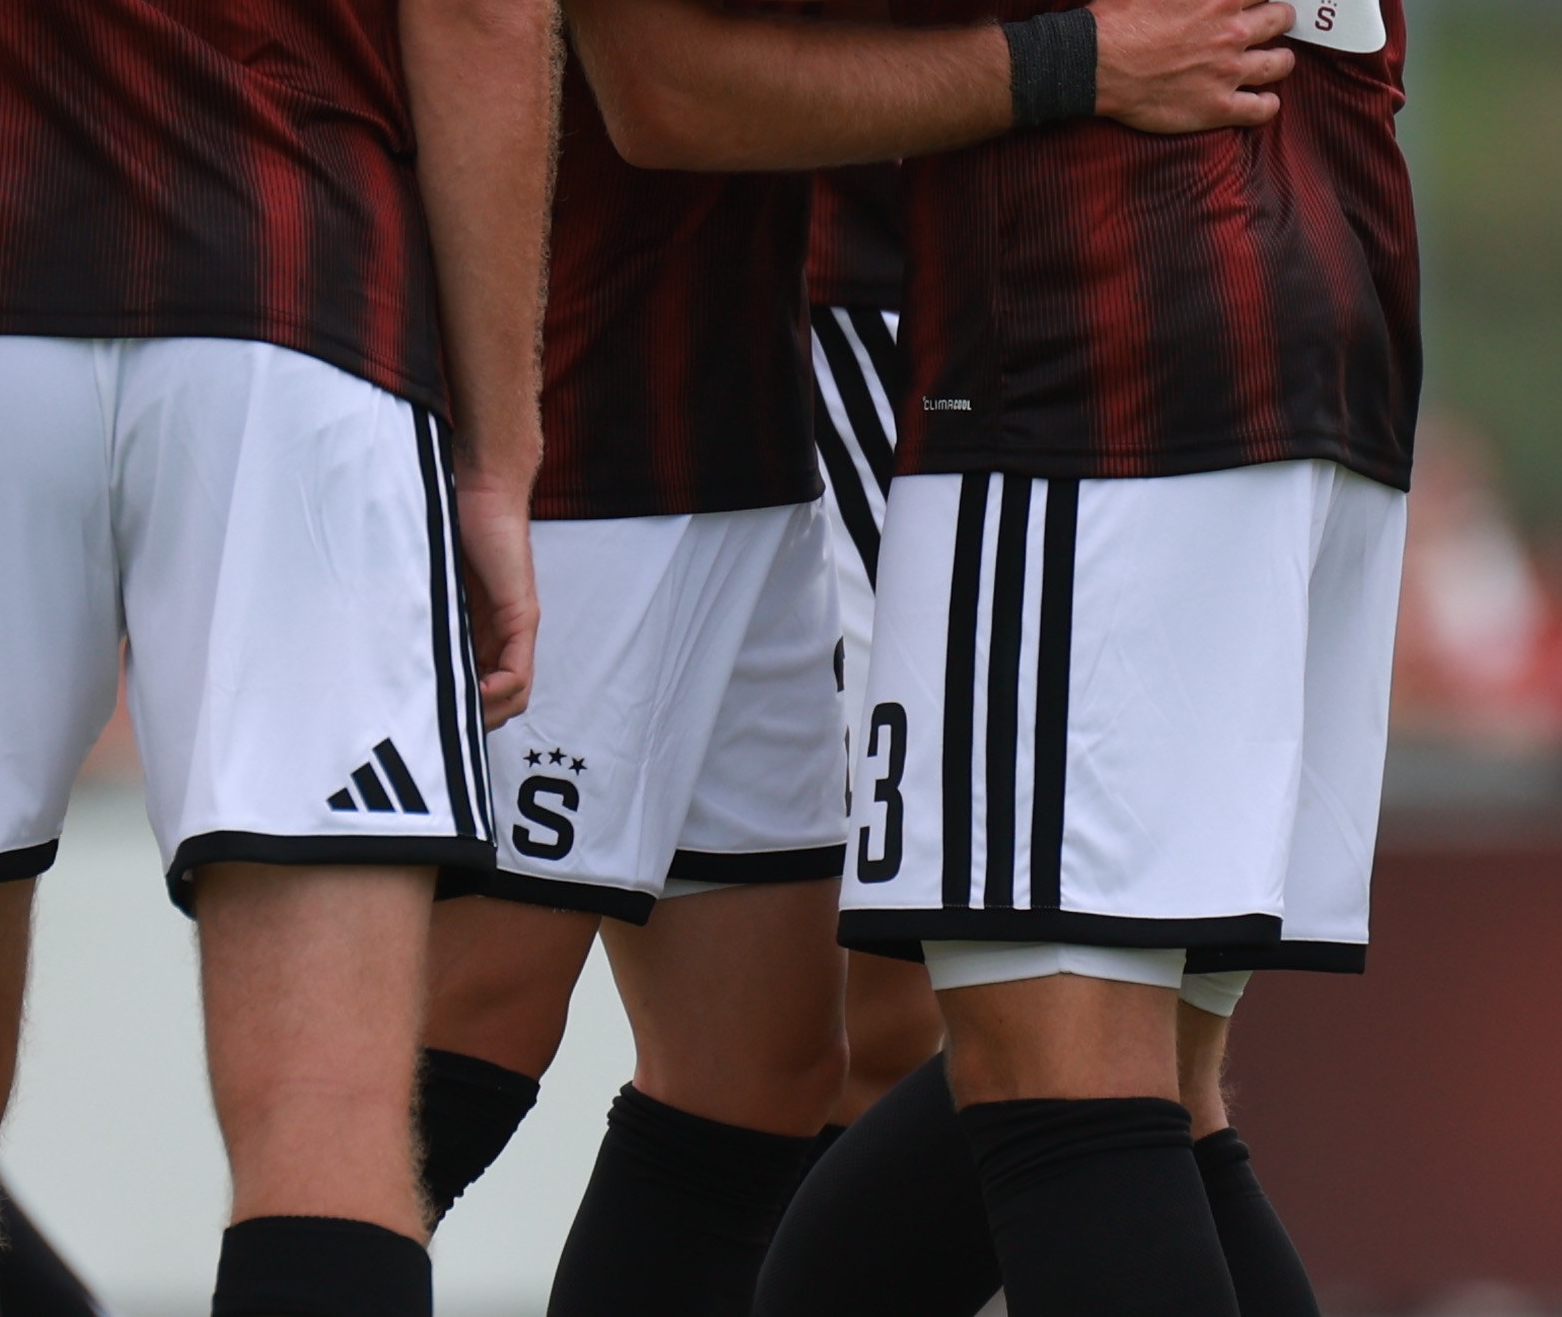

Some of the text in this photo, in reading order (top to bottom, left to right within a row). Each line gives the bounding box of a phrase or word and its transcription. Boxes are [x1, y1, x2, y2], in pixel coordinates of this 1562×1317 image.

[1315, 6, 1336, 31] S
[512, 774, 580, 861] S
[857, 701, 908, 885] 3
